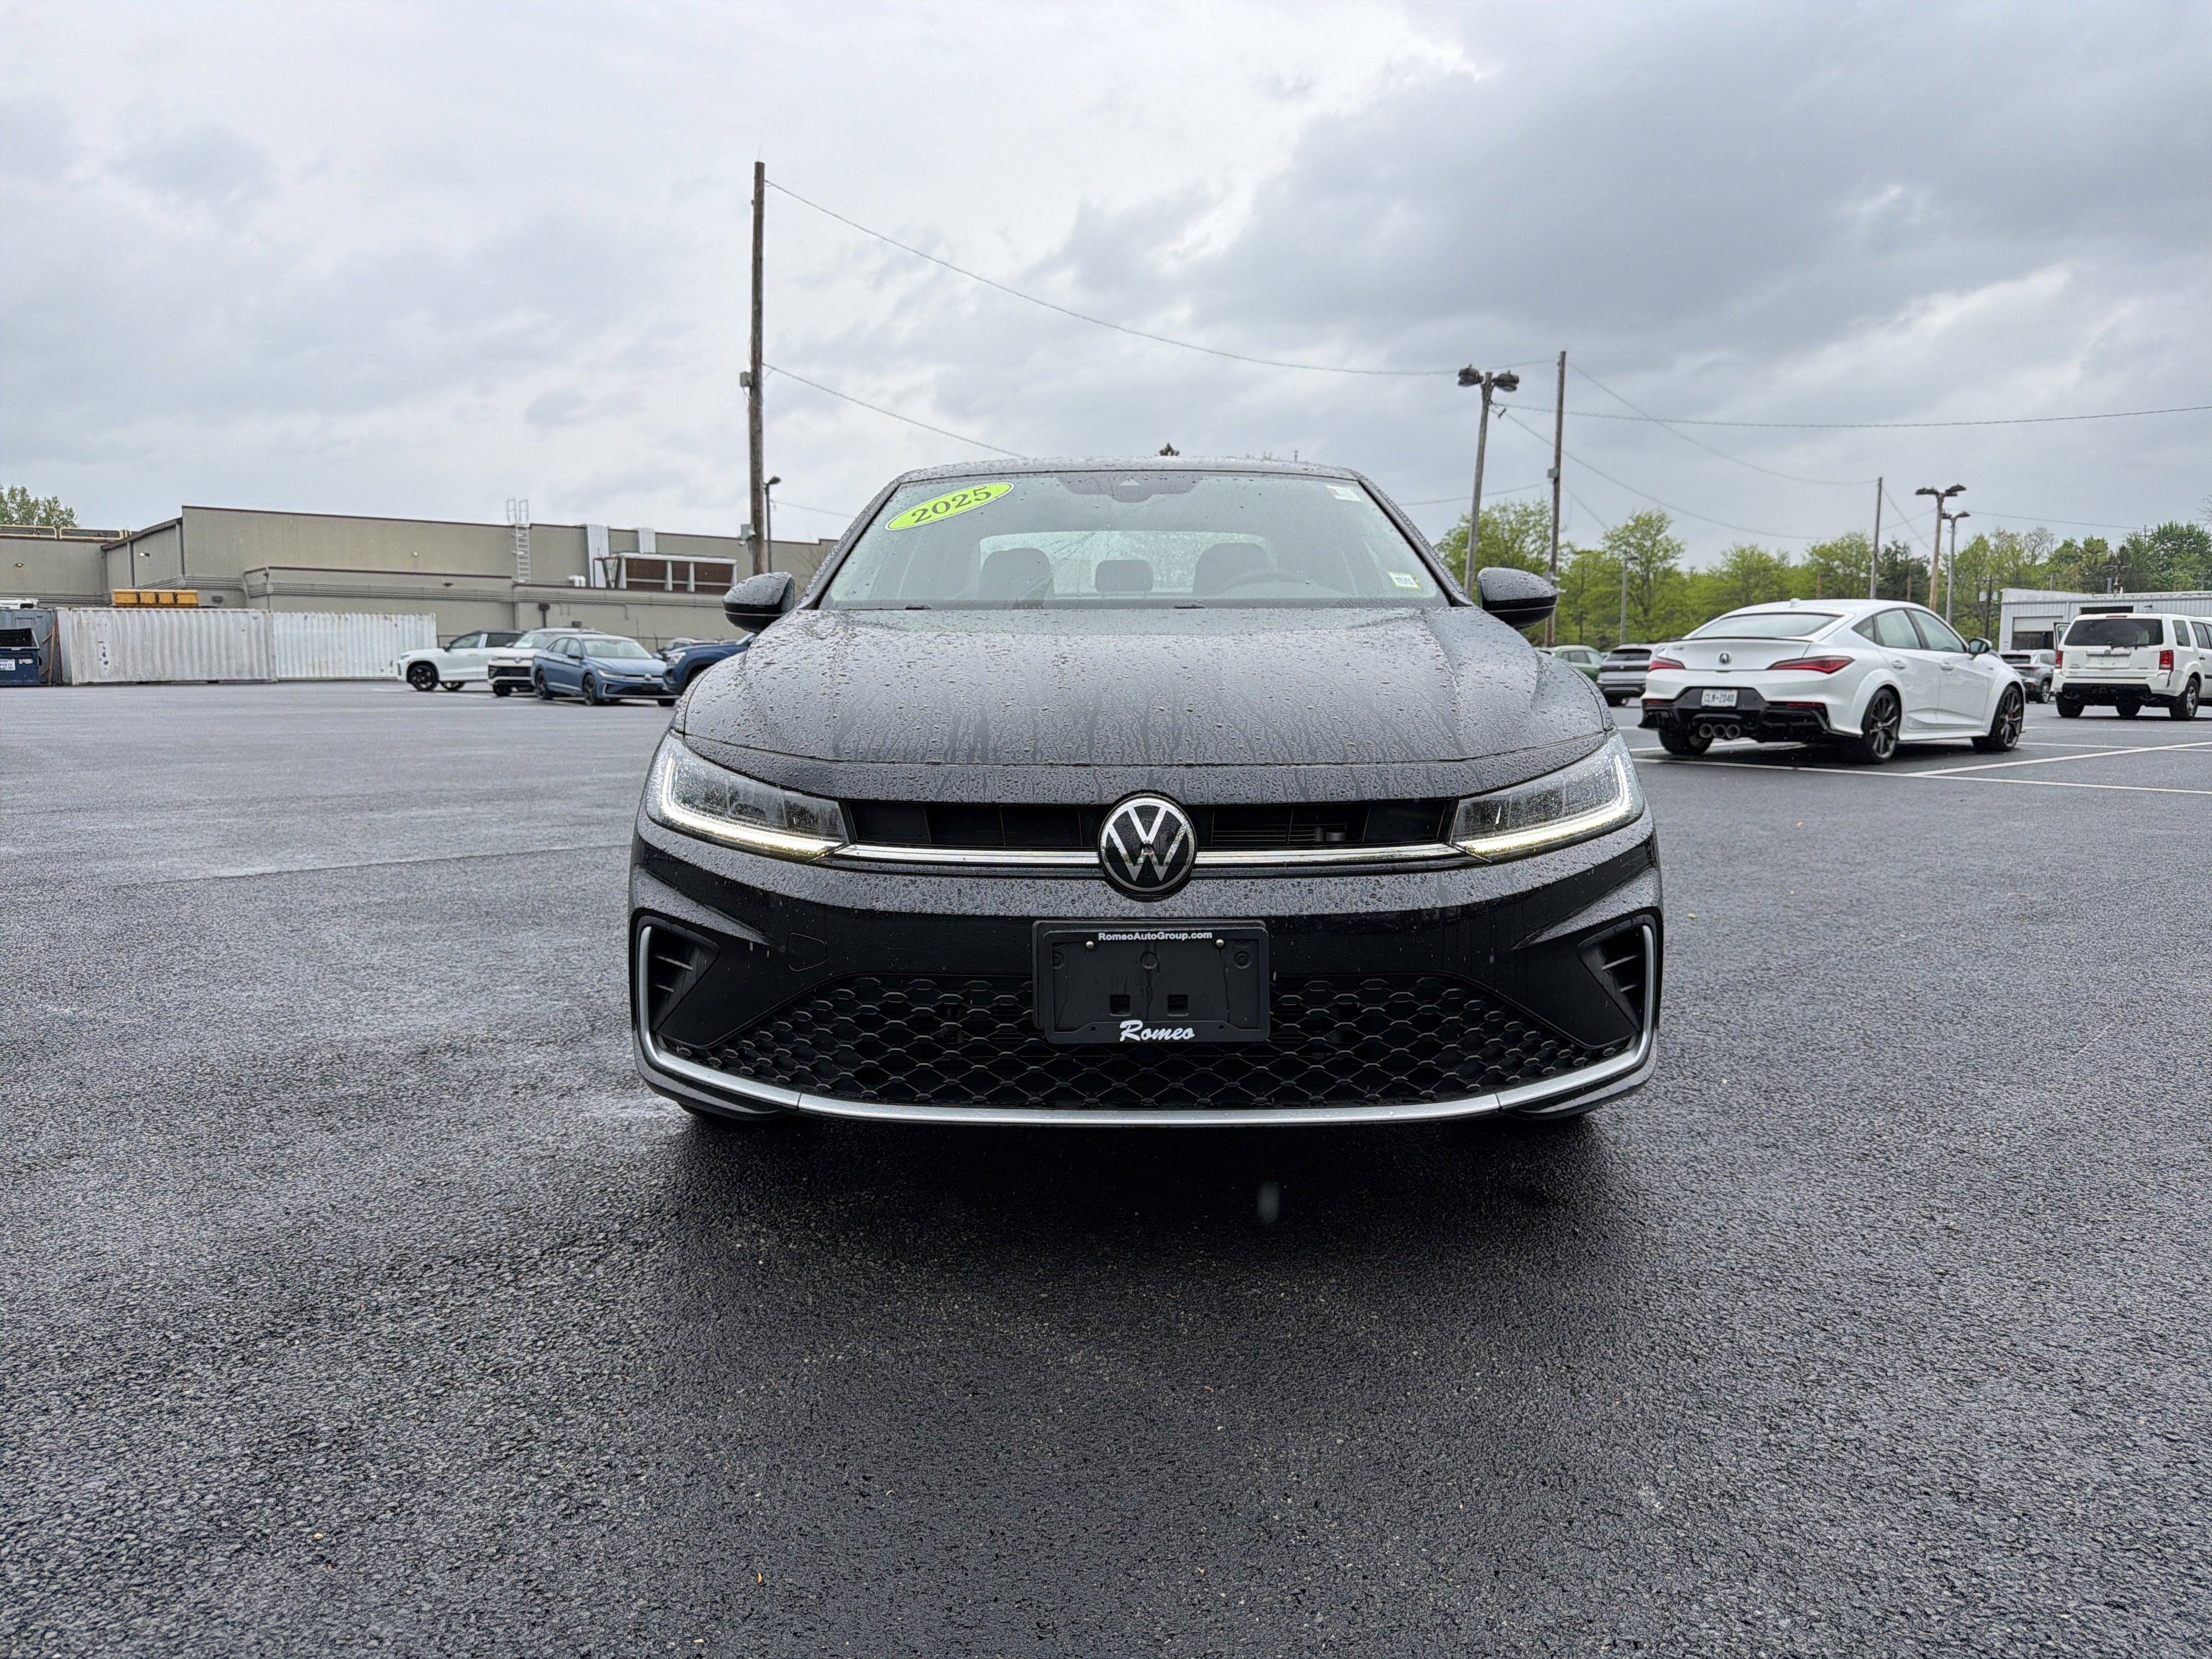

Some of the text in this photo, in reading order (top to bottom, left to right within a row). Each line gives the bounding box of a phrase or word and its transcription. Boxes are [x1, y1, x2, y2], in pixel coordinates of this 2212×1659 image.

[911, 486, 992, 524] 2025
[1098, 932, 1212, 941] RomeoAutoGroup.com
[1119, 1019, 1195, 1042] Romeo
